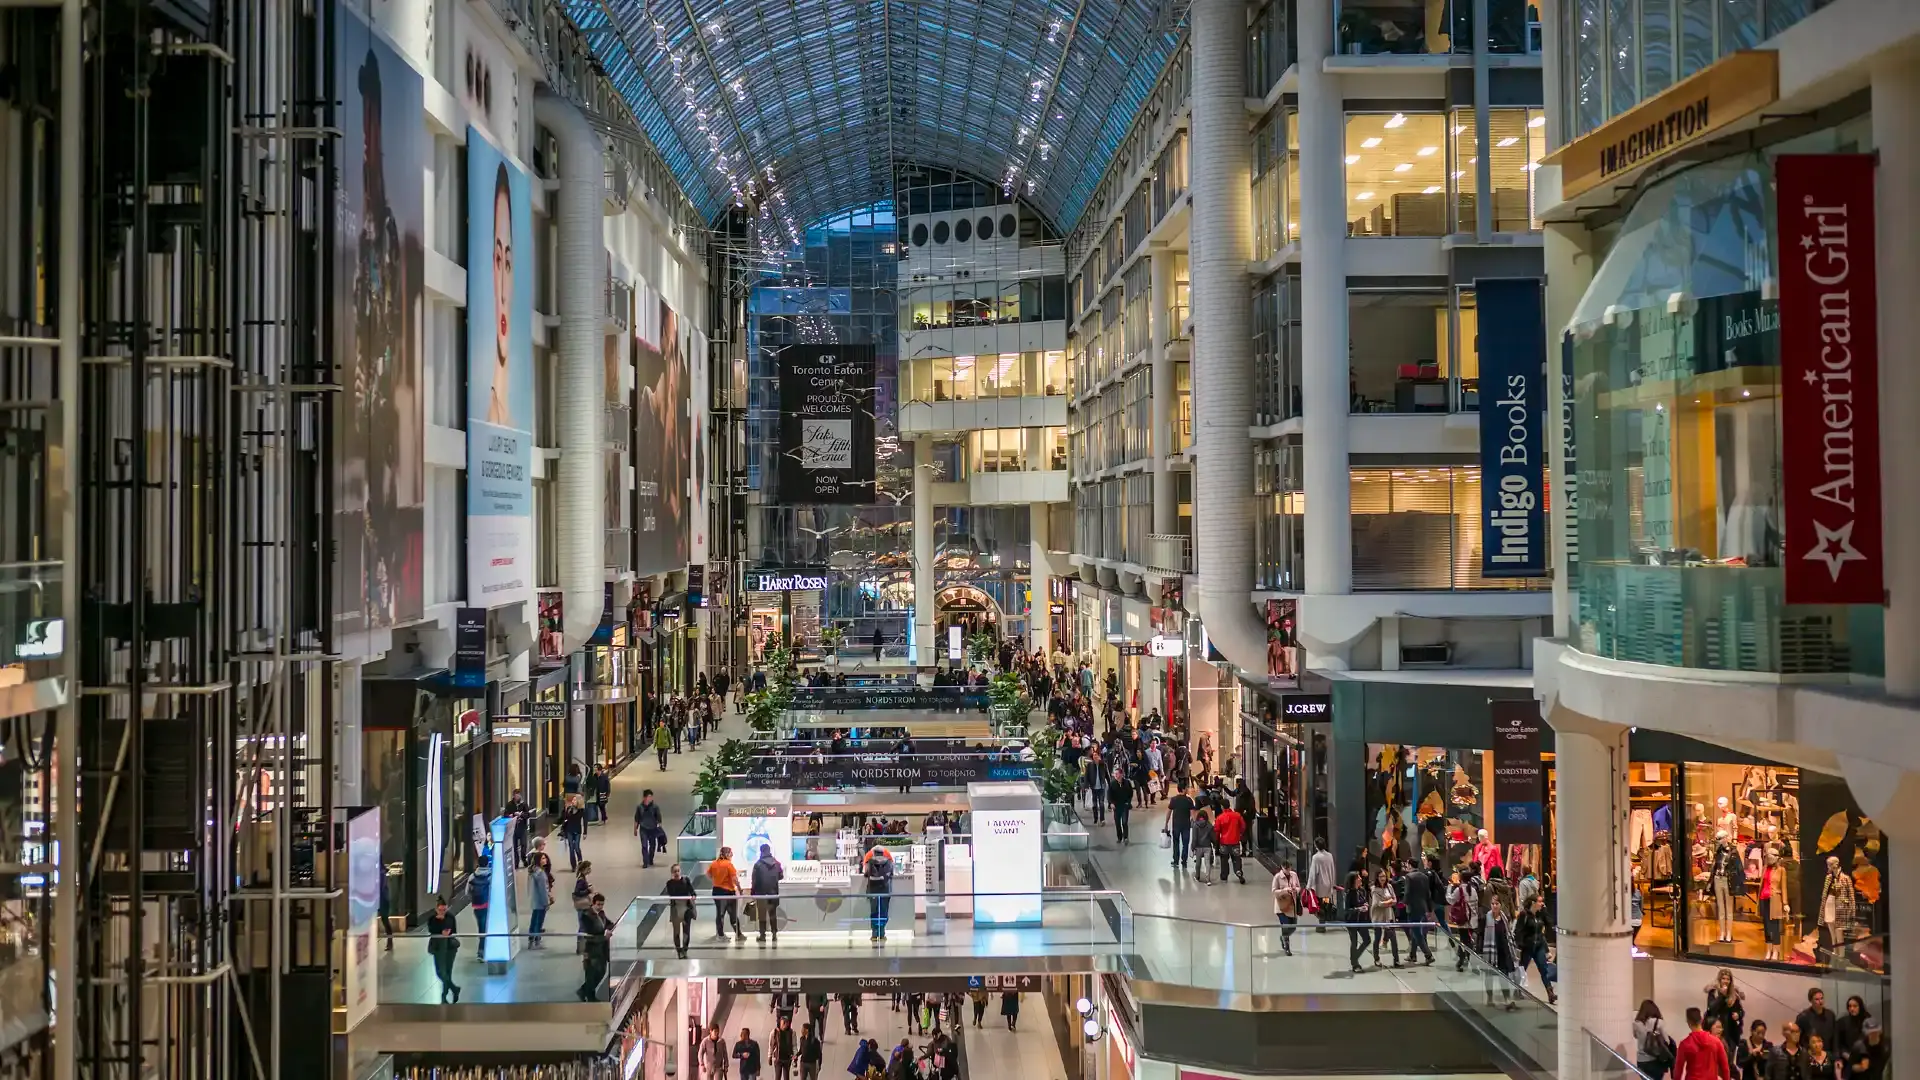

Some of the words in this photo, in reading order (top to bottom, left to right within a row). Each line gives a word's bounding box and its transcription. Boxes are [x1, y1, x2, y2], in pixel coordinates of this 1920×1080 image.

[1600, 95, 1709, 178] IMAGINATION
[1725, 308, 1753, 341] Books
[792, 365, 831, 375] Toronto
[833, 365, 863, 375] Eaton
[806, 394, 847, 403] PROUDLY
[1803, 289, 1855, 513] American
[802, 405, 852, 413] WELCOMES
[1496, 374, 1528, 466] Books
[803, 425, 835, 444] Saks
[803, 445, 847, 463] Aenue
[815, 475, 838, 484] NOW
[814, 485, 840, 494] OPEN
[1491, 474, 1535, 563] Indigo
[759, 574, 795, 591] HARRY
[793, 574, 828, 590] ROSEN
[865, 696, 916, 704] NORDSTROM
[1286, 703, 1327, 714] J.CREW
[802, 771, 844, 779] WELCOMES
[851, 768, 921, 778] NORDSTROM
[927, 770, 938, 778] TO
[940, 769, 976, 777] TORONTO
[993, 769, 1010, 777] NOW
[857, 978, 888, 987] Queen
[889, 977, 901, 987] St.
